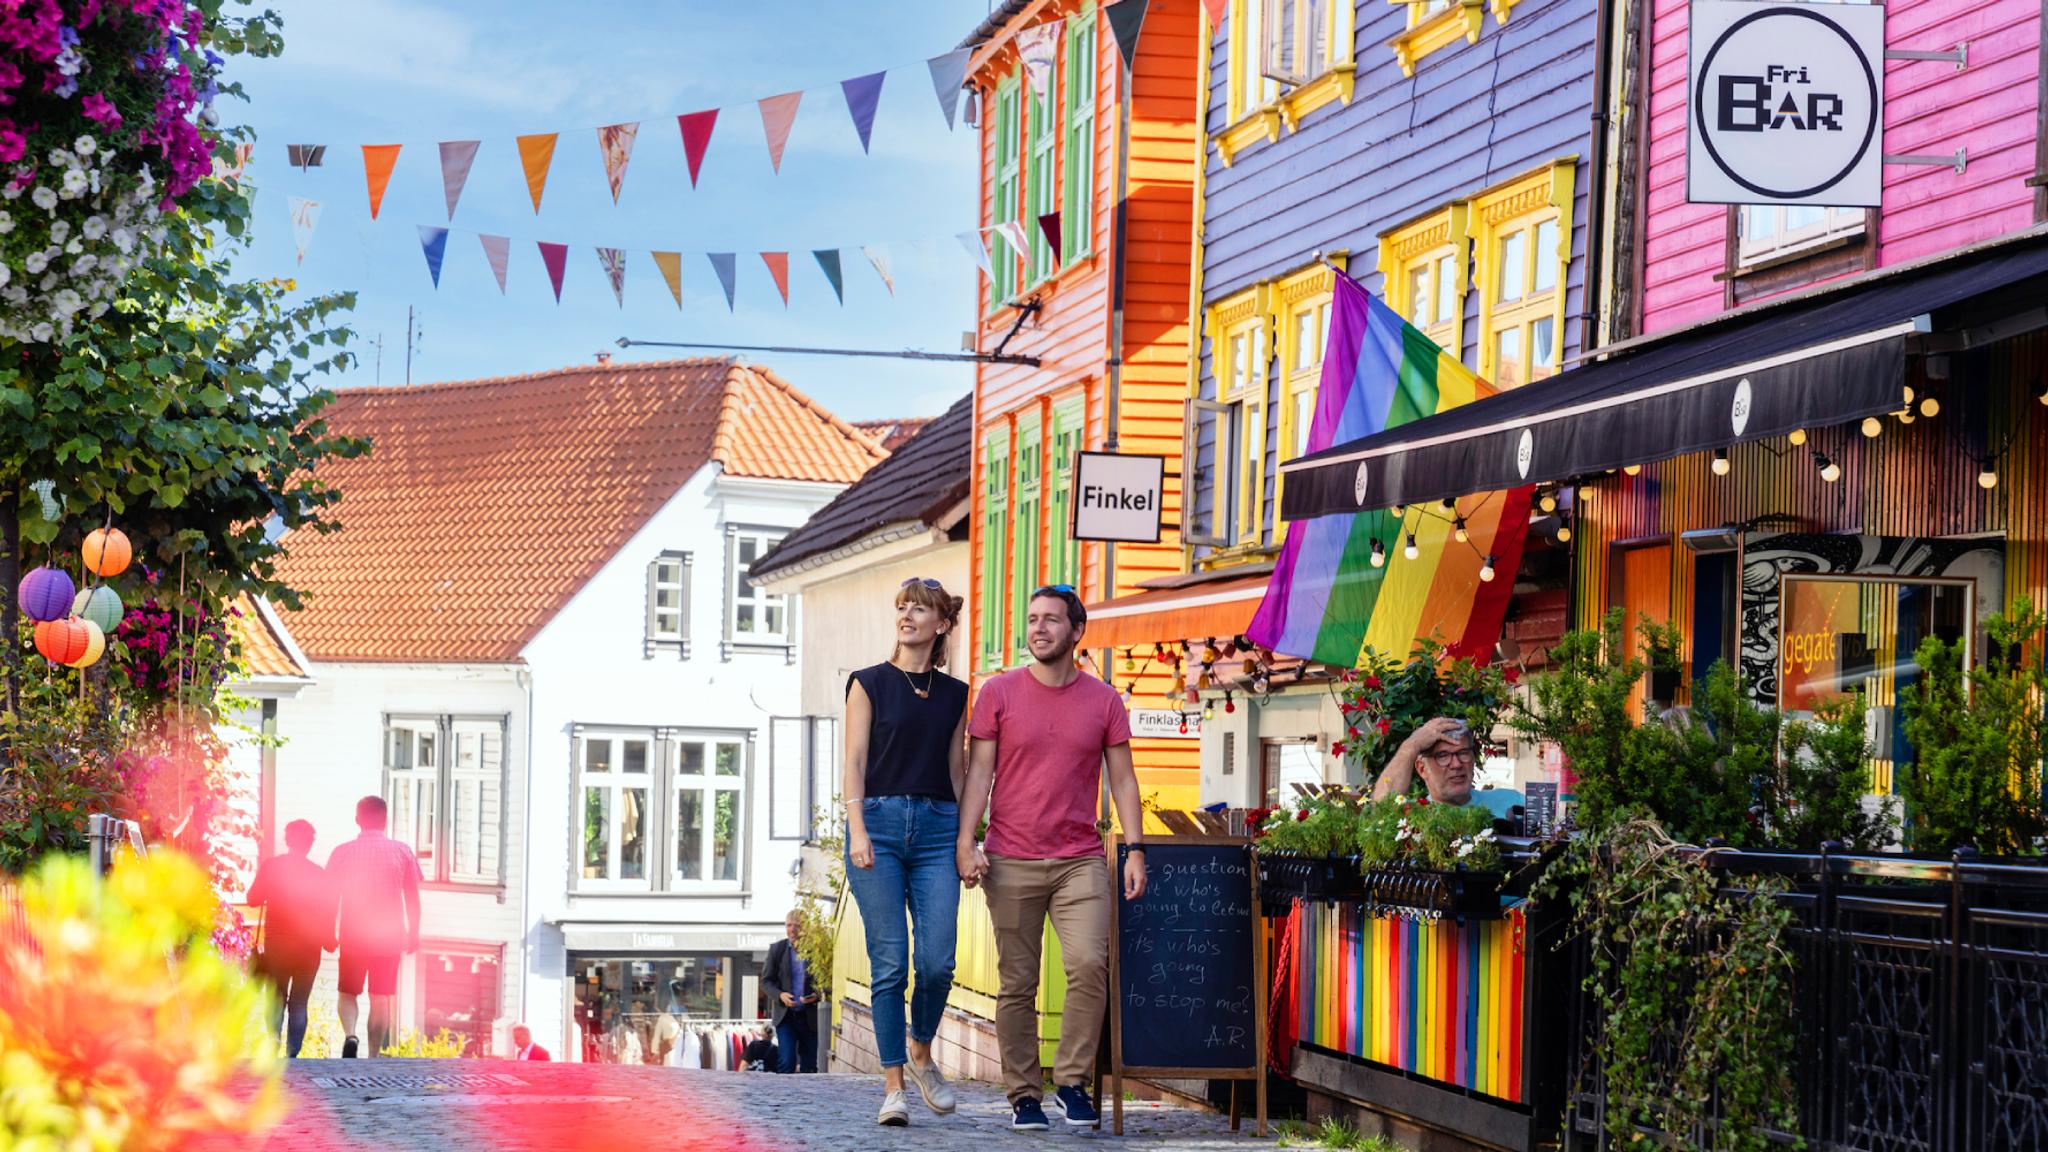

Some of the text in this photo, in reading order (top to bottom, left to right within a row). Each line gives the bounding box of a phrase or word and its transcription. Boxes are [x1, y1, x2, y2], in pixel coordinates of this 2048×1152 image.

[1767, 65, 1811, 84] Fri
[1717, 75, 1843, 132] BAR
[1083, 486, 1153, 511] Finkel
[1162, 856, 1248, 882] question
[1174, 878, 1222, 897] who's
[1127, 902, 1182, 925] going
[1188, 898, 1206, 913] to
[1127, 933, 1222, 955] it's who's
[1148, 961, 1206, 984] going
[1127, 983, 1250, 1018] to stop me?
